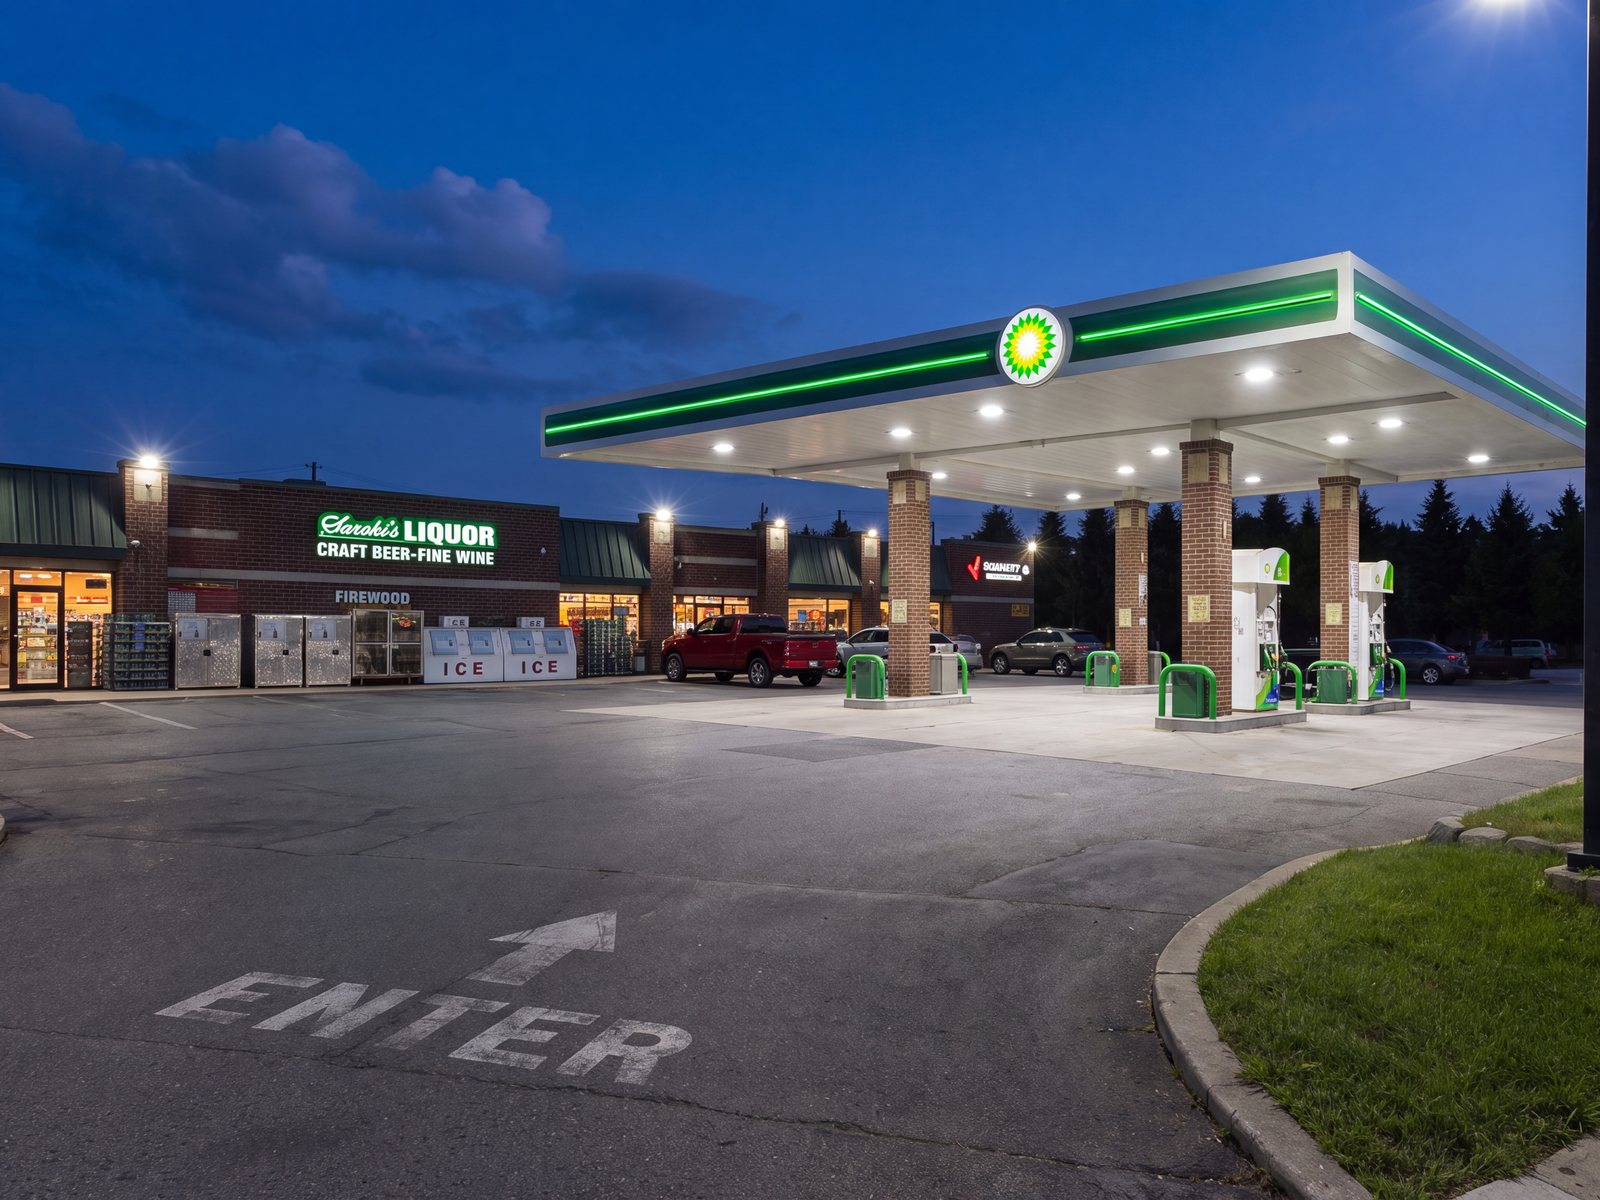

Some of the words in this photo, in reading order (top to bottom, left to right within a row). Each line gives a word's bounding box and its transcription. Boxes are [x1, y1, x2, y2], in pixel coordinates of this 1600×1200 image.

[404, 520, 495, 547] LIQUOR
[317, 542, 367, 558] CRAFT
[455, 550, 494, 565] WINE
[335, 590, 410, 604] FIREWOOD
[443, 661, 483, 676] ICE
[521, 660, 558, 674] ICE
[153, 971, 693, 1086] ENTER
